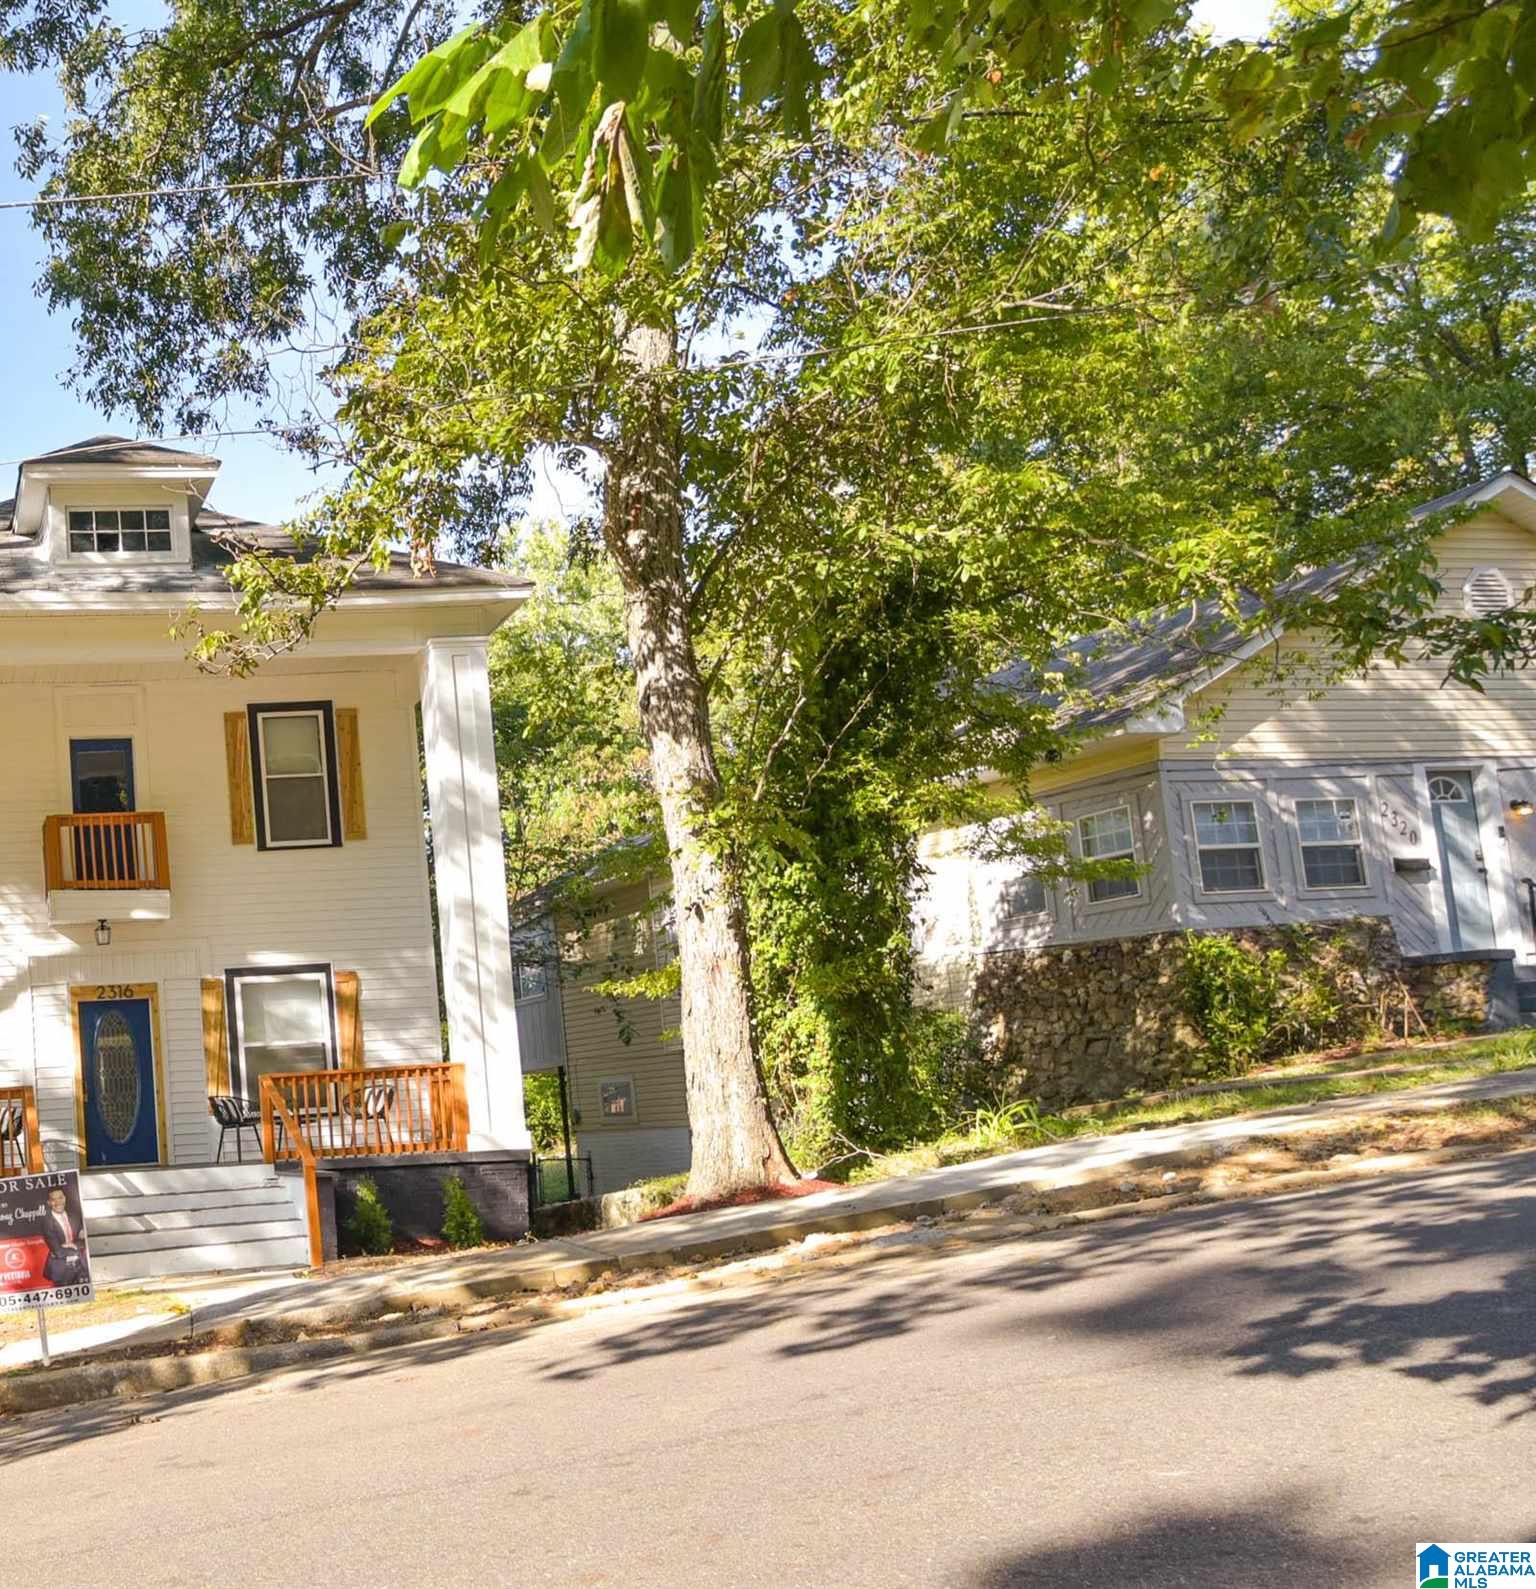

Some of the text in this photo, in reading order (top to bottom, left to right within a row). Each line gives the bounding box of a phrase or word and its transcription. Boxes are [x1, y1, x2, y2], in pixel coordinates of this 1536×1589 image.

[1381, 801, 1418, 845] 2320
[96, 984, 134, 1000] 2316
[25, 1174, 67, 1190] SALE
